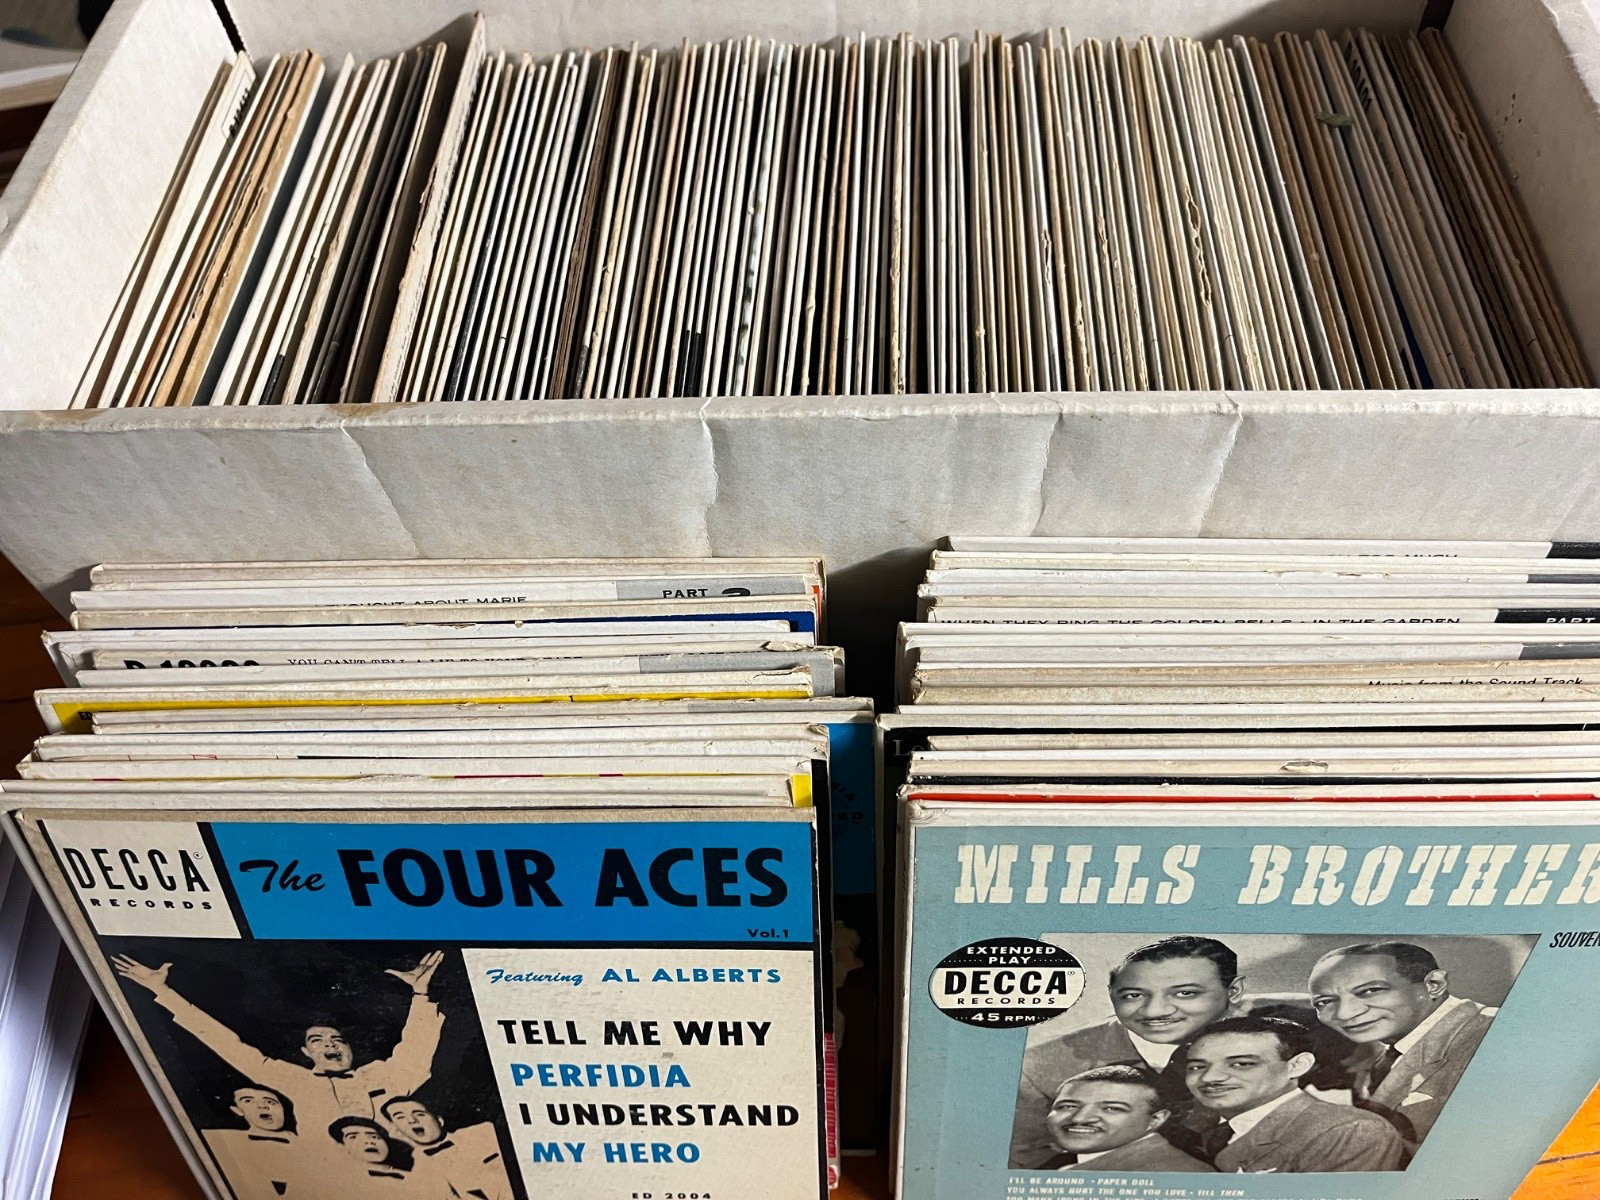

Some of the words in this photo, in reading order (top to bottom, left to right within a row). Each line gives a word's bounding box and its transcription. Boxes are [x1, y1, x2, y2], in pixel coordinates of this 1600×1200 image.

[662, 588, 708, 598] PART
[1543, 676, 1583, 685] Track
[62, 847, 211, 893] DECCA
[953, 844, 1201, 905] MILLS
[239, 859, 326, 894] The
[336, 847, 564, 908] FOUR
[594, 847, 789, 908] ACES
[89, 898, 213, 911] RECORDS
[746, 927, 789, 939] Vol.1
[966, 946, 1057, 955] EXTENDED
[988, 956, 1031, 965] PLAY
[485, 968, 585, 987] Featuring
[601, 968, 641, 983] AL
[651, 968, 782, 984] ALBERTS
[944, 970, 1068, 995] DECCA
[957, 997, 1056, 1005] RECORDS
[970, 1012, 1001, 1022] 45
[497, 1019, 587, 1046] TELL
[603, 1020, 662, 1047] ME
[673, 1020, 772, 1047] WHY
[510, 1063, 692, 1088] PERFIDIA
[518, 1103, 532, 1126] I
[546, 1103, 800, 1127] UNDERSTAND
[532, 1141, 587, 1163] MY
[603, 1142, 701, 1163] HERO
[1045, 1177, 1085, 1185] AROUND
[1097, 1178, 1128, 1186] PAPER
[1131, 1178, 1154, 1186] DOLL
[631, 1192, 653, 1200] ED
[664, 1192, 711, 1200] 2004
[1007, 1186, 1025, 1194] YOU
[1098, 1187, 1115, 1195] THE
[1142, 1188, 1162, 1196] YOU
[1165, 1188, 1186, 1196] LOVE
[1220, 1189, 1245, 1197] THEN
